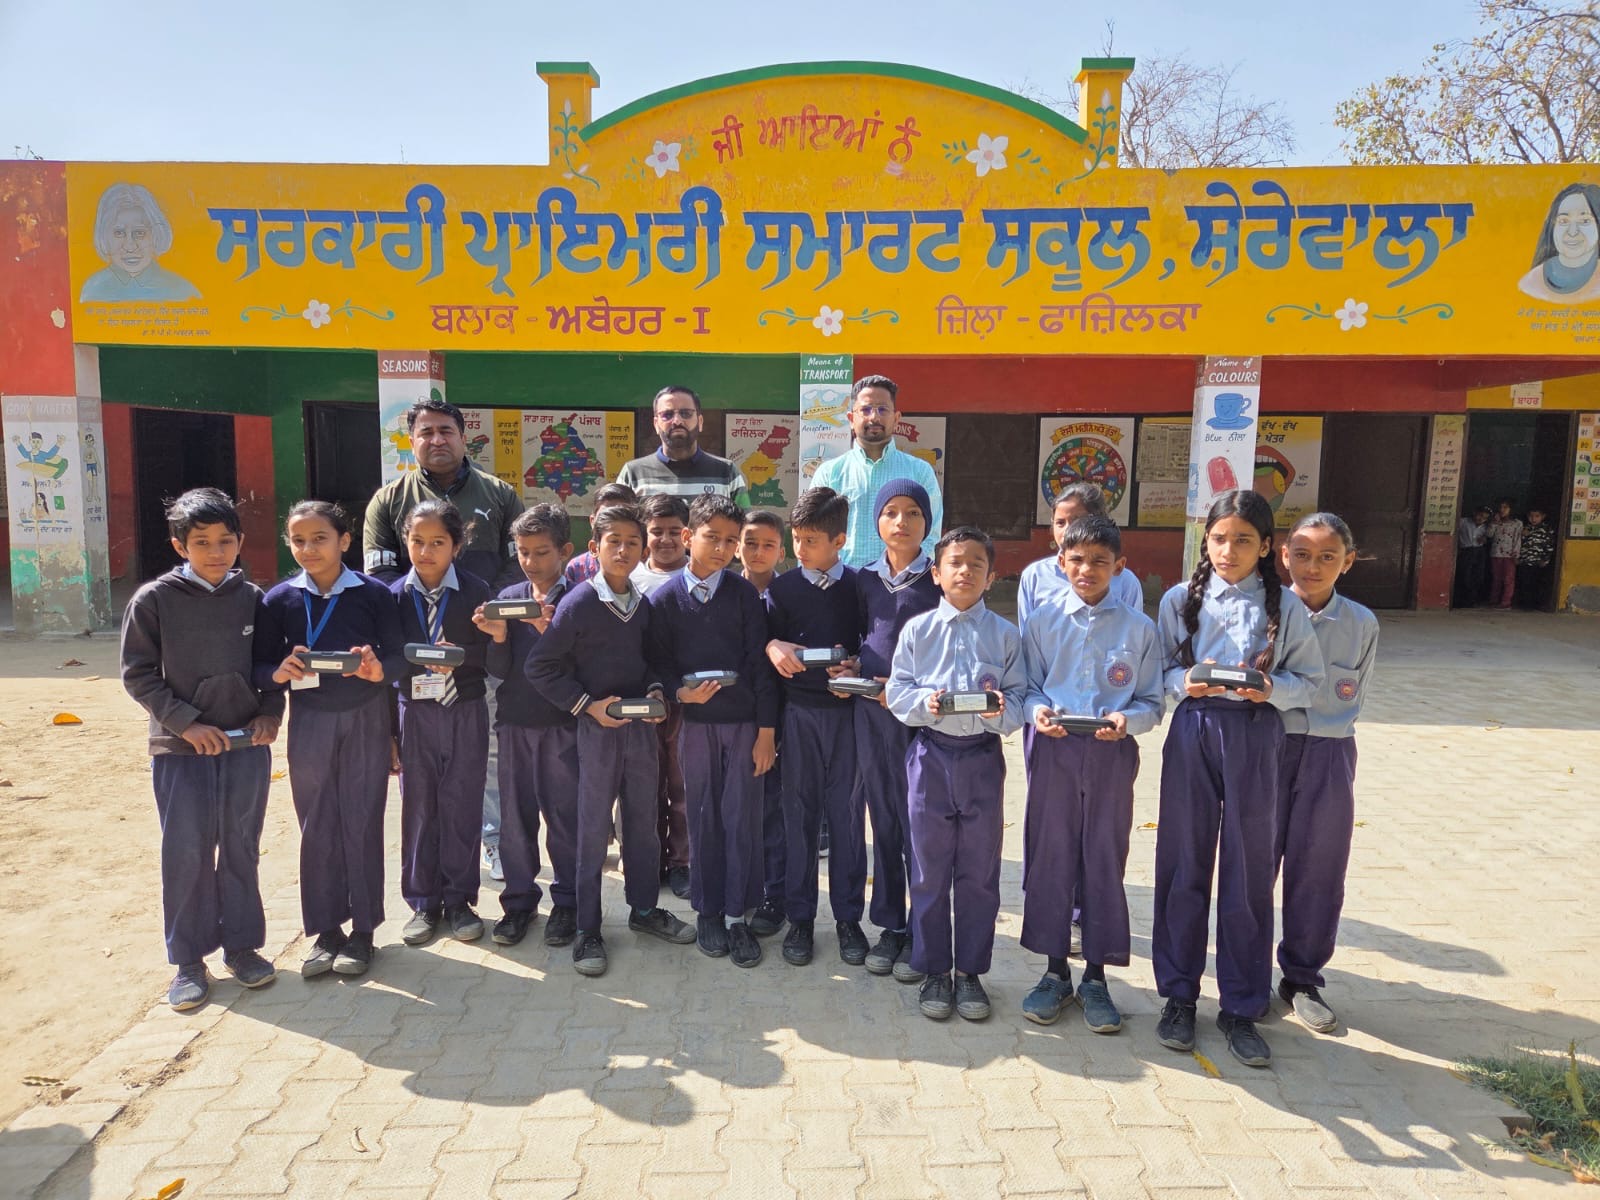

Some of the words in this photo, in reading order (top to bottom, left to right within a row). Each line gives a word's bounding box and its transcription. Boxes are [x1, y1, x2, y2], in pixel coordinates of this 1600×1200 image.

[711, 114, 744, 164] ਜੀ
[757, 104, 884, 152] ਆਇਆਂ
[206, 183, 447, 286] ਸਰਕਾਰੀ
[461, 185, 724, 298] ਪ੍ਰਾਇਮਰੀ
[743, 208, 964, 291] ਸਮਾਰਟ
[1184, 179, 1475, 288] ਸ਼ੇਰੇਵਾਲਾ
[429, 305, 519, 335] ਬਲਾਕ
[545, 295, 666, 335] ਅਬੋਹਰ
[1039, 292, 1202, 335] ਫਾਜ਼ਿਲਕਾ
[382, 359, 428, 373] SEASONS
[803, 369, 851, 381] TRANSPORT
[1214, 357, 1239, 368] Name
[1243, 357, 1253, 369] of
[1208, 371, 1258, 383] COLOURS
